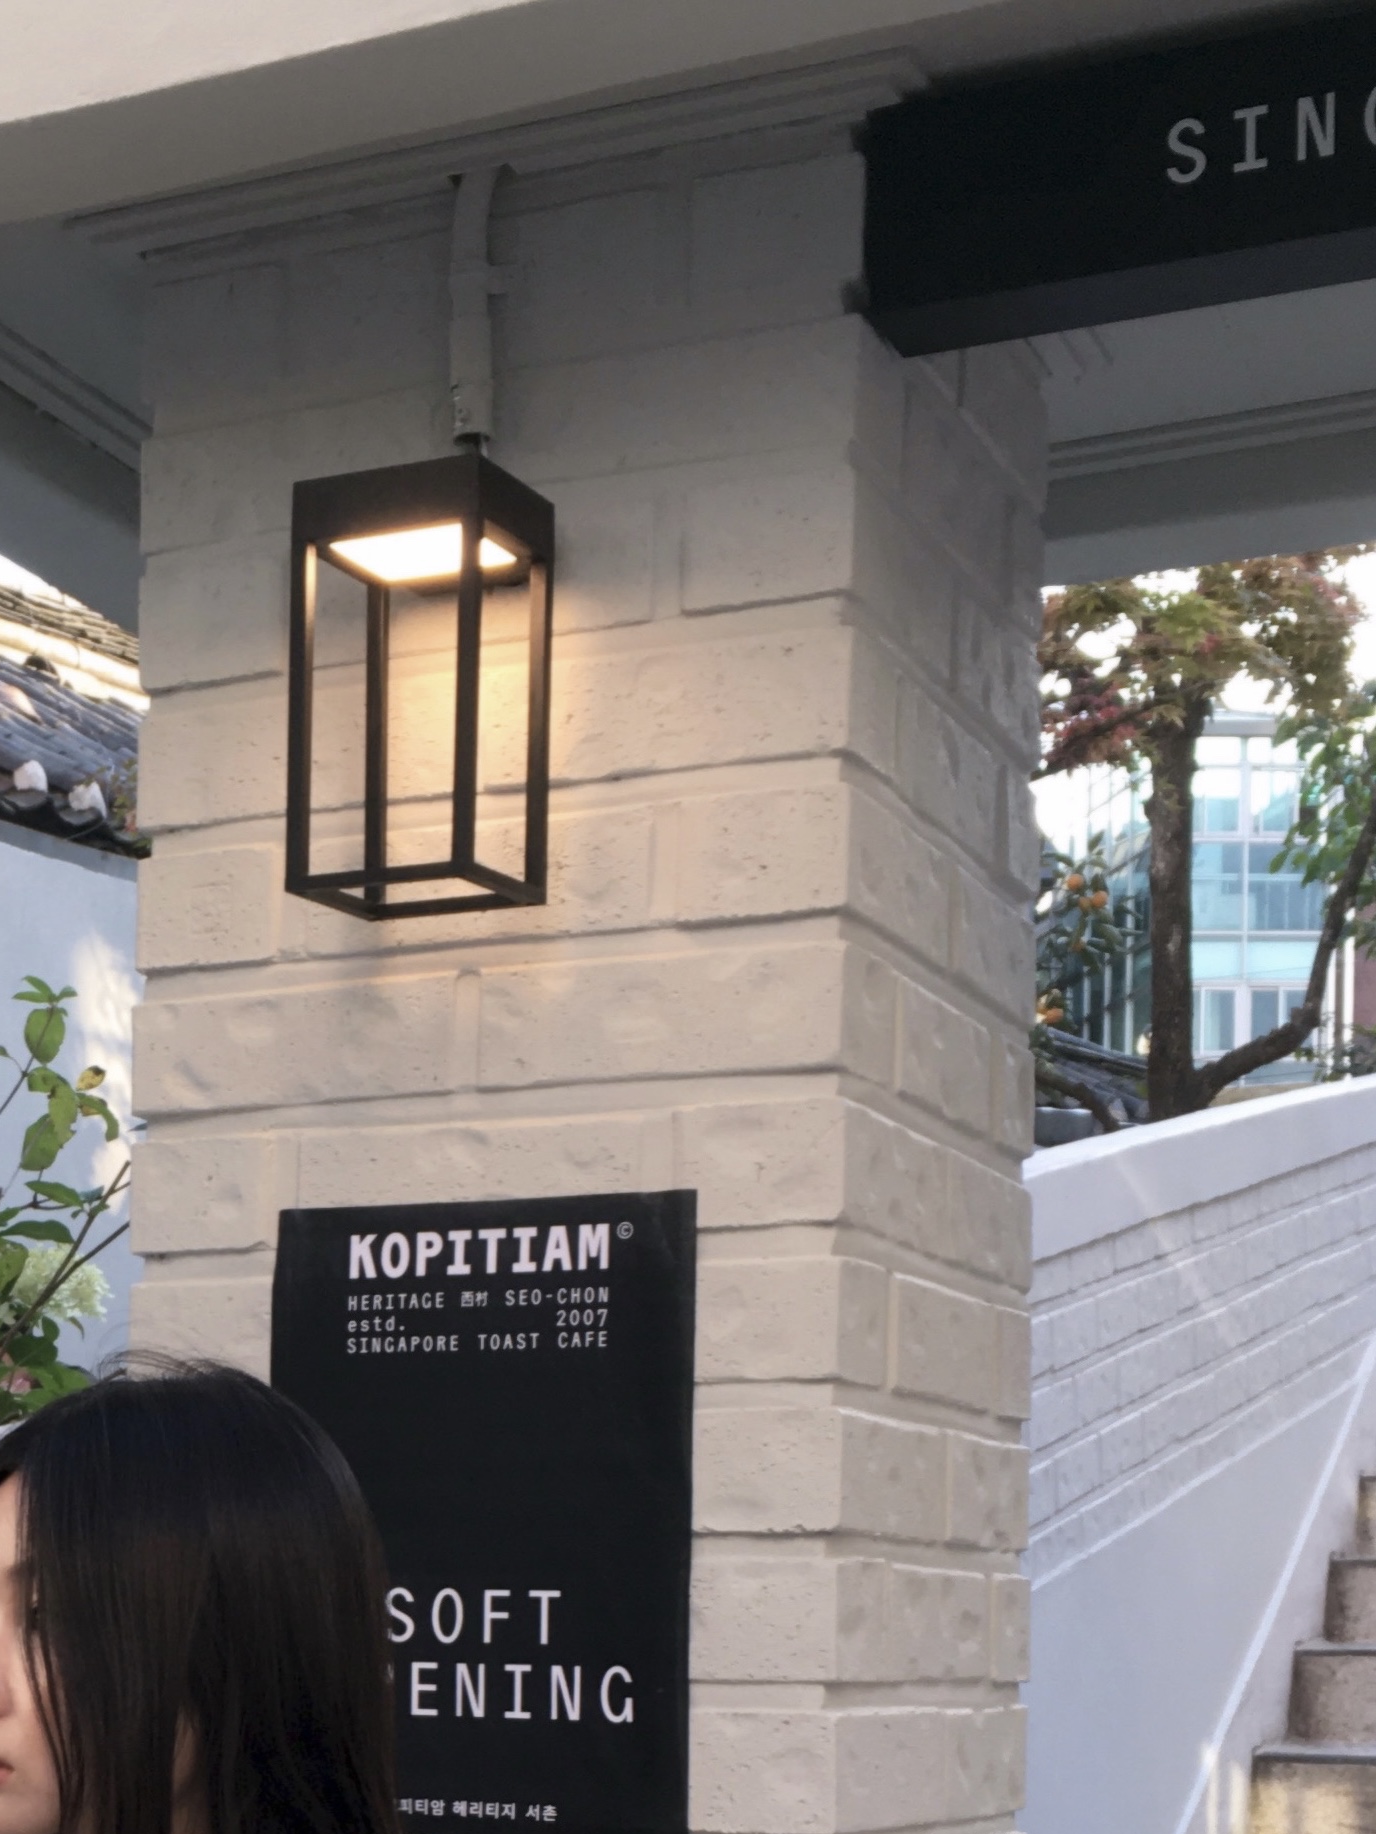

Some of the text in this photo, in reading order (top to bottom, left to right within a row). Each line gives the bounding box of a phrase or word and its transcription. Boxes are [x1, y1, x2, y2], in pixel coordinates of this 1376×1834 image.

[347, 1291, 446, 1312] HERITAGE
[504, 1286, 609, 1307] SEO-CHON
[347, 1308, 609, 1333] estd. 2007
[346, 1330, 608, 1354] SINGAPORE TOAST CAFE
[384, 1586, 562, 1645] SOFT
[386, 1660, 634, 1724] ENING
[392, 1797, 558, 1822] 피티암 헤리티지 서촌
